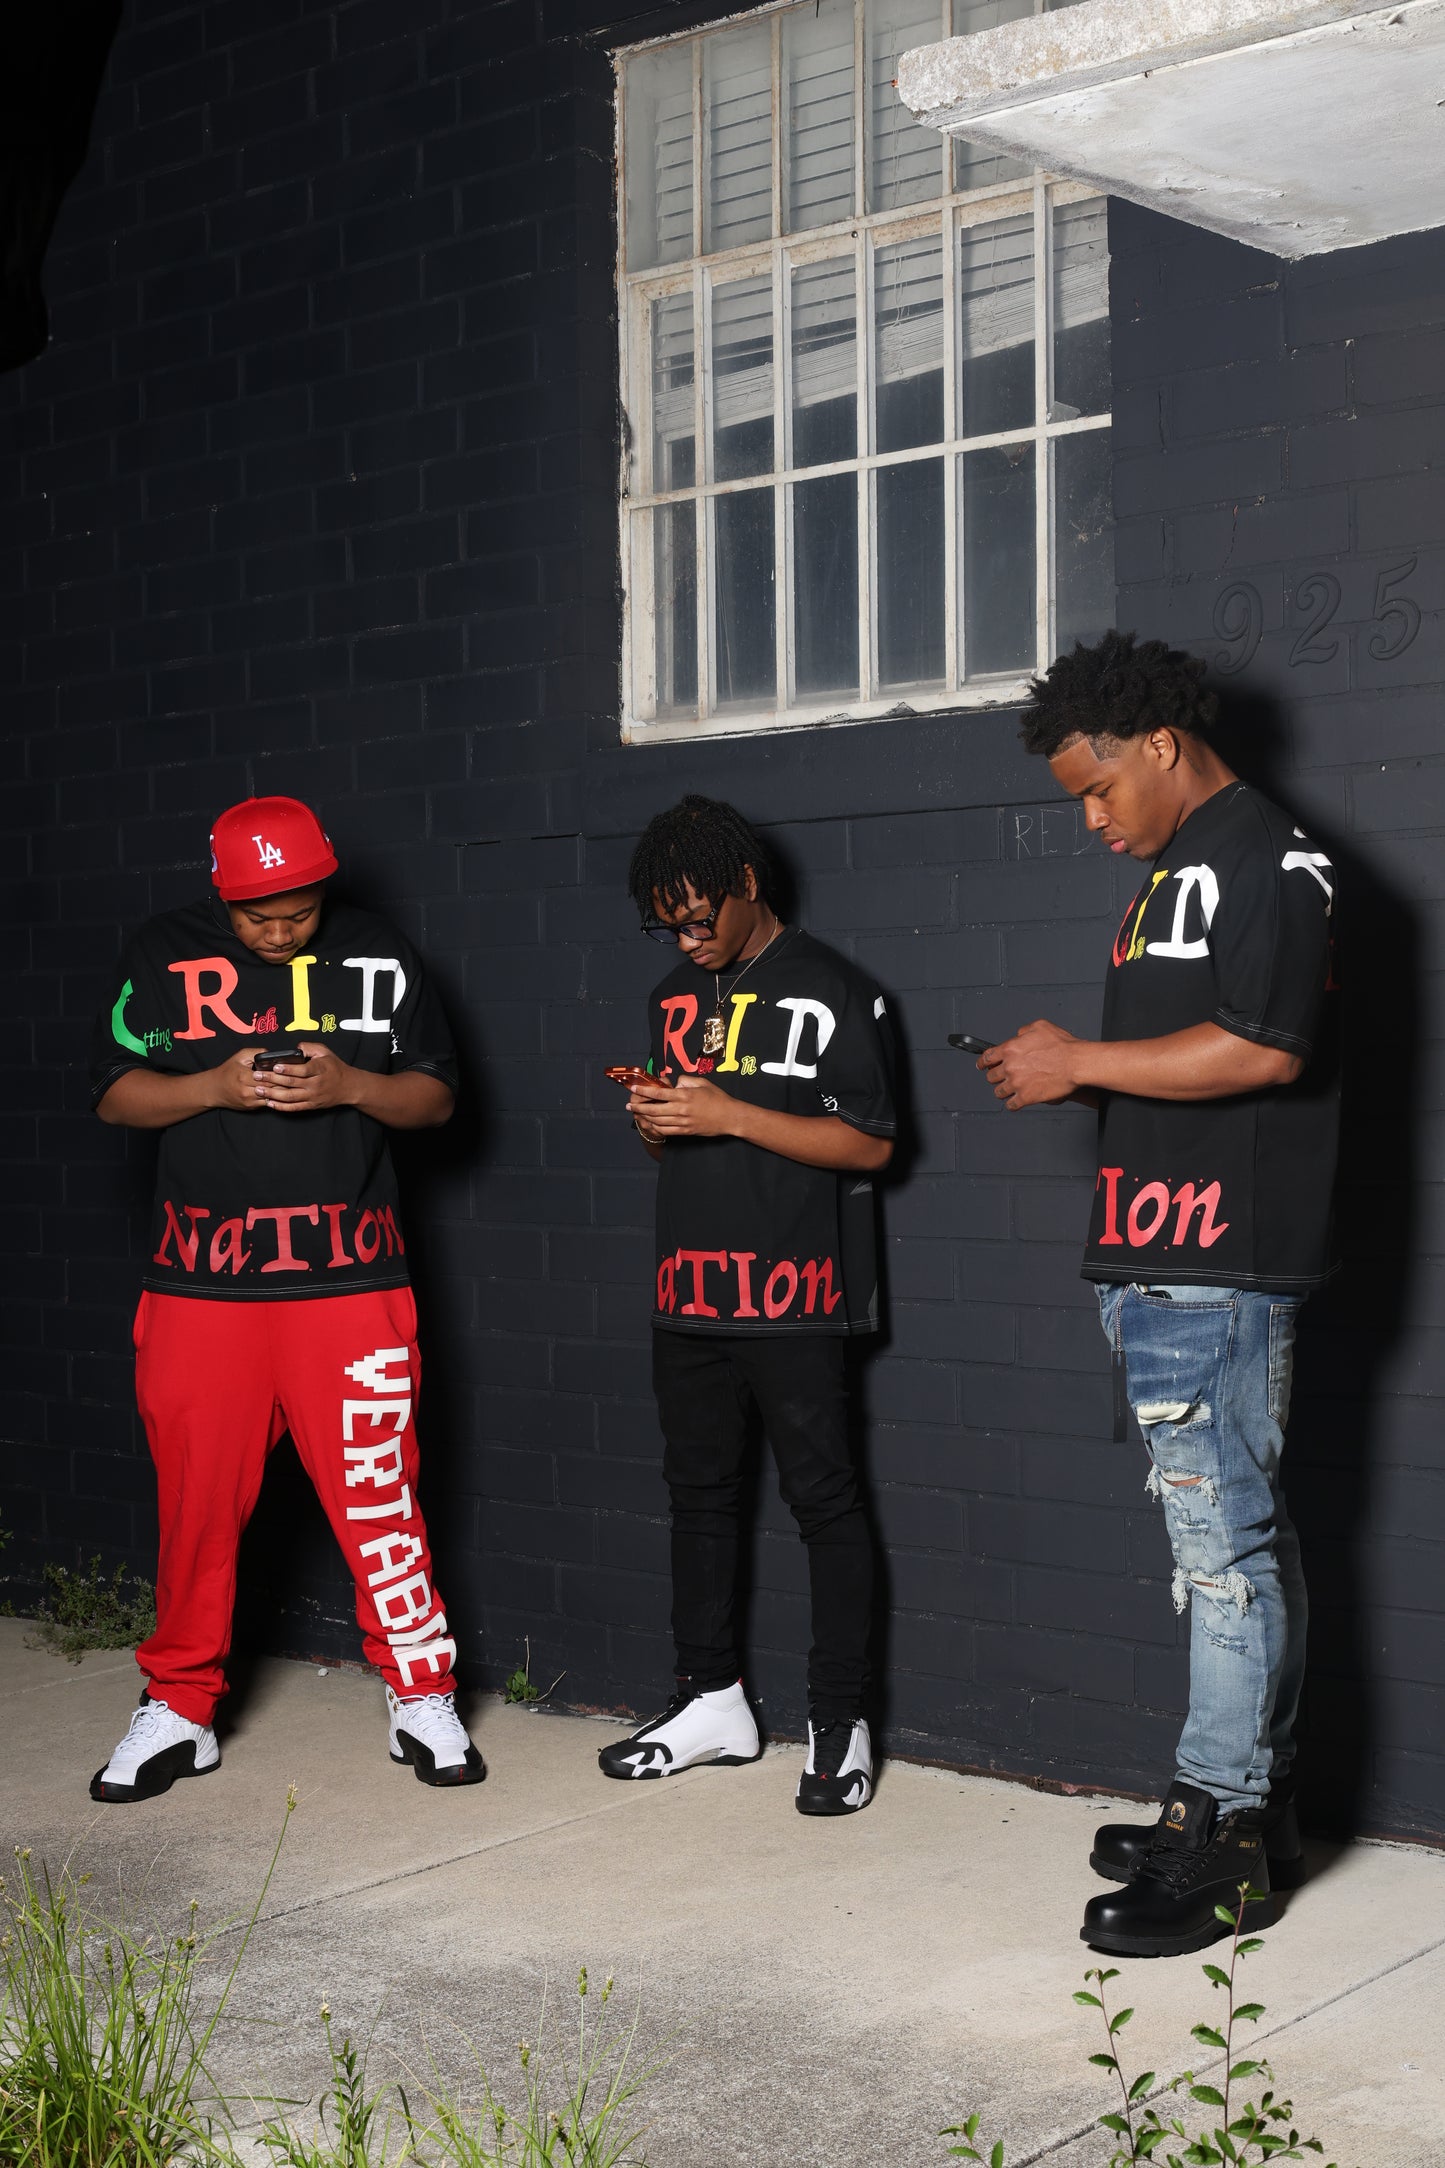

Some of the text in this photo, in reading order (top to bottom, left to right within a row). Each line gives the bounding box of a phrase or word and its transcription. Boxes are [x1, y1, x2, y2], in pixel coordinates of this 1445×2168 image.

[1213, 557, 1422, 675] 925
[252, 835, 285, 869] LA
[1015, 806, 1097, 861] RED
